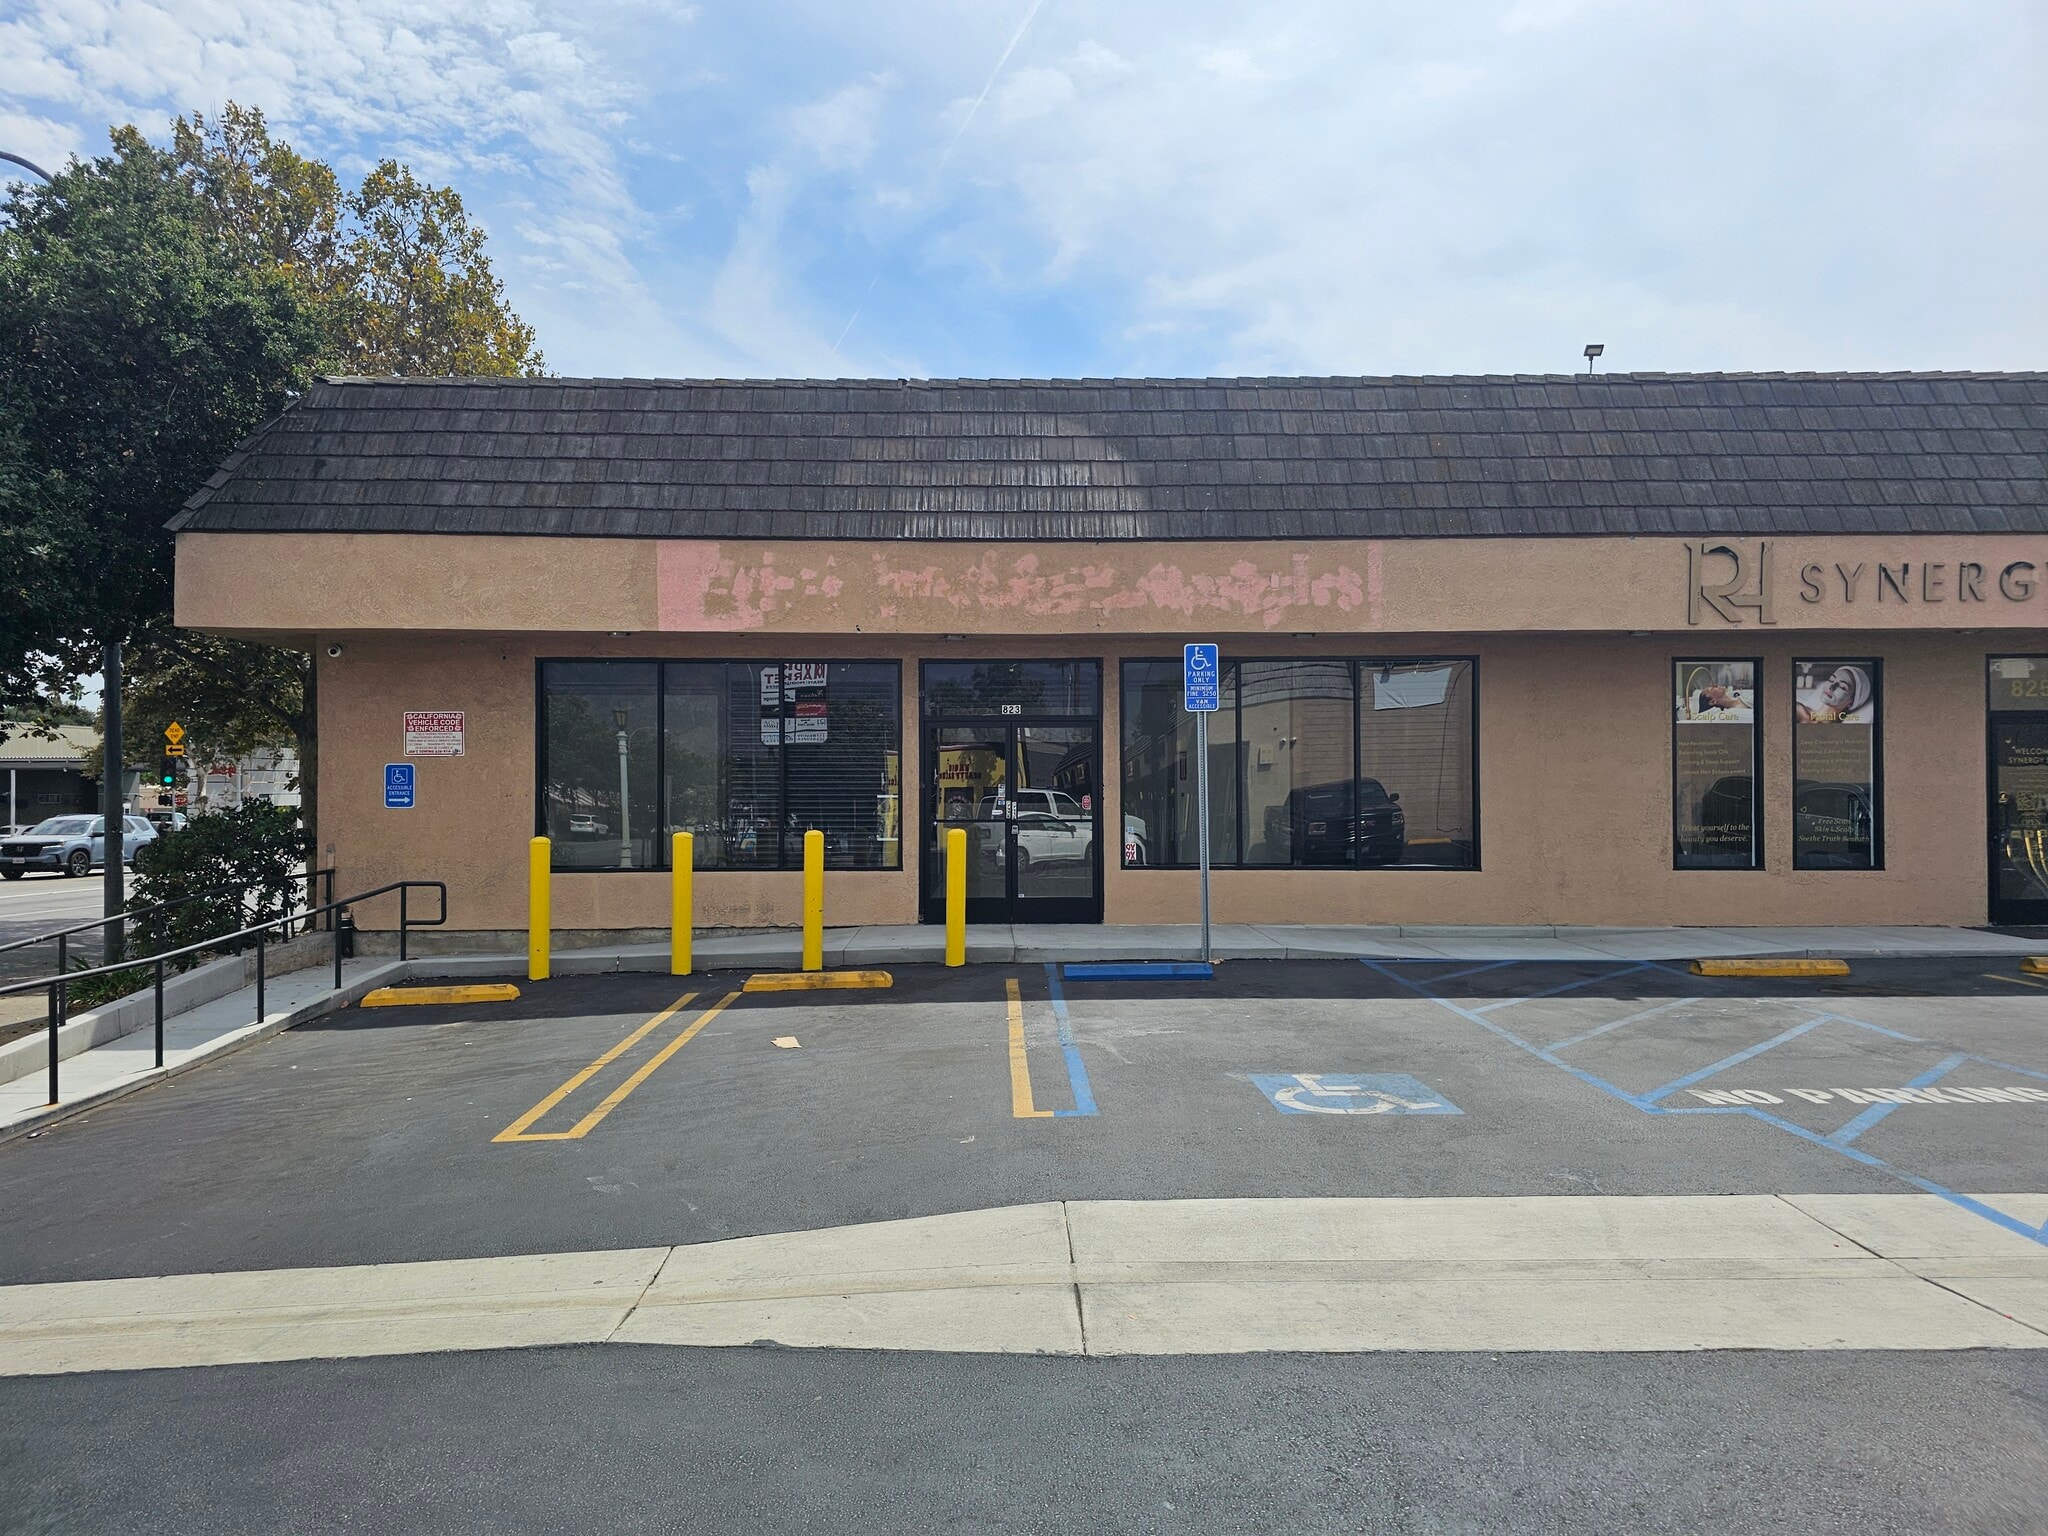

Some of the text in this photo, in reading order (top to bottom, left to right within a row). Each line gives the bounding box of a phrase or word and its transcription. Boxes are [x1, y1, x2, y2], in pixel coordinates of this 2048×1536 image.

[1800, 561, 2048, 603] SYNERG
[1002, 705, 1020, 714] 823
[1692, 712, 1739, 722] Scalp Care
[1810, 711, 1860, 720] Facial Care
[1700, 823, 1729, 833] yourself
[1738, 823, 1750, 831] the
[1719, 834, 1748, 842] deserve.
[1685, 1089, 1784, 1105] NO
